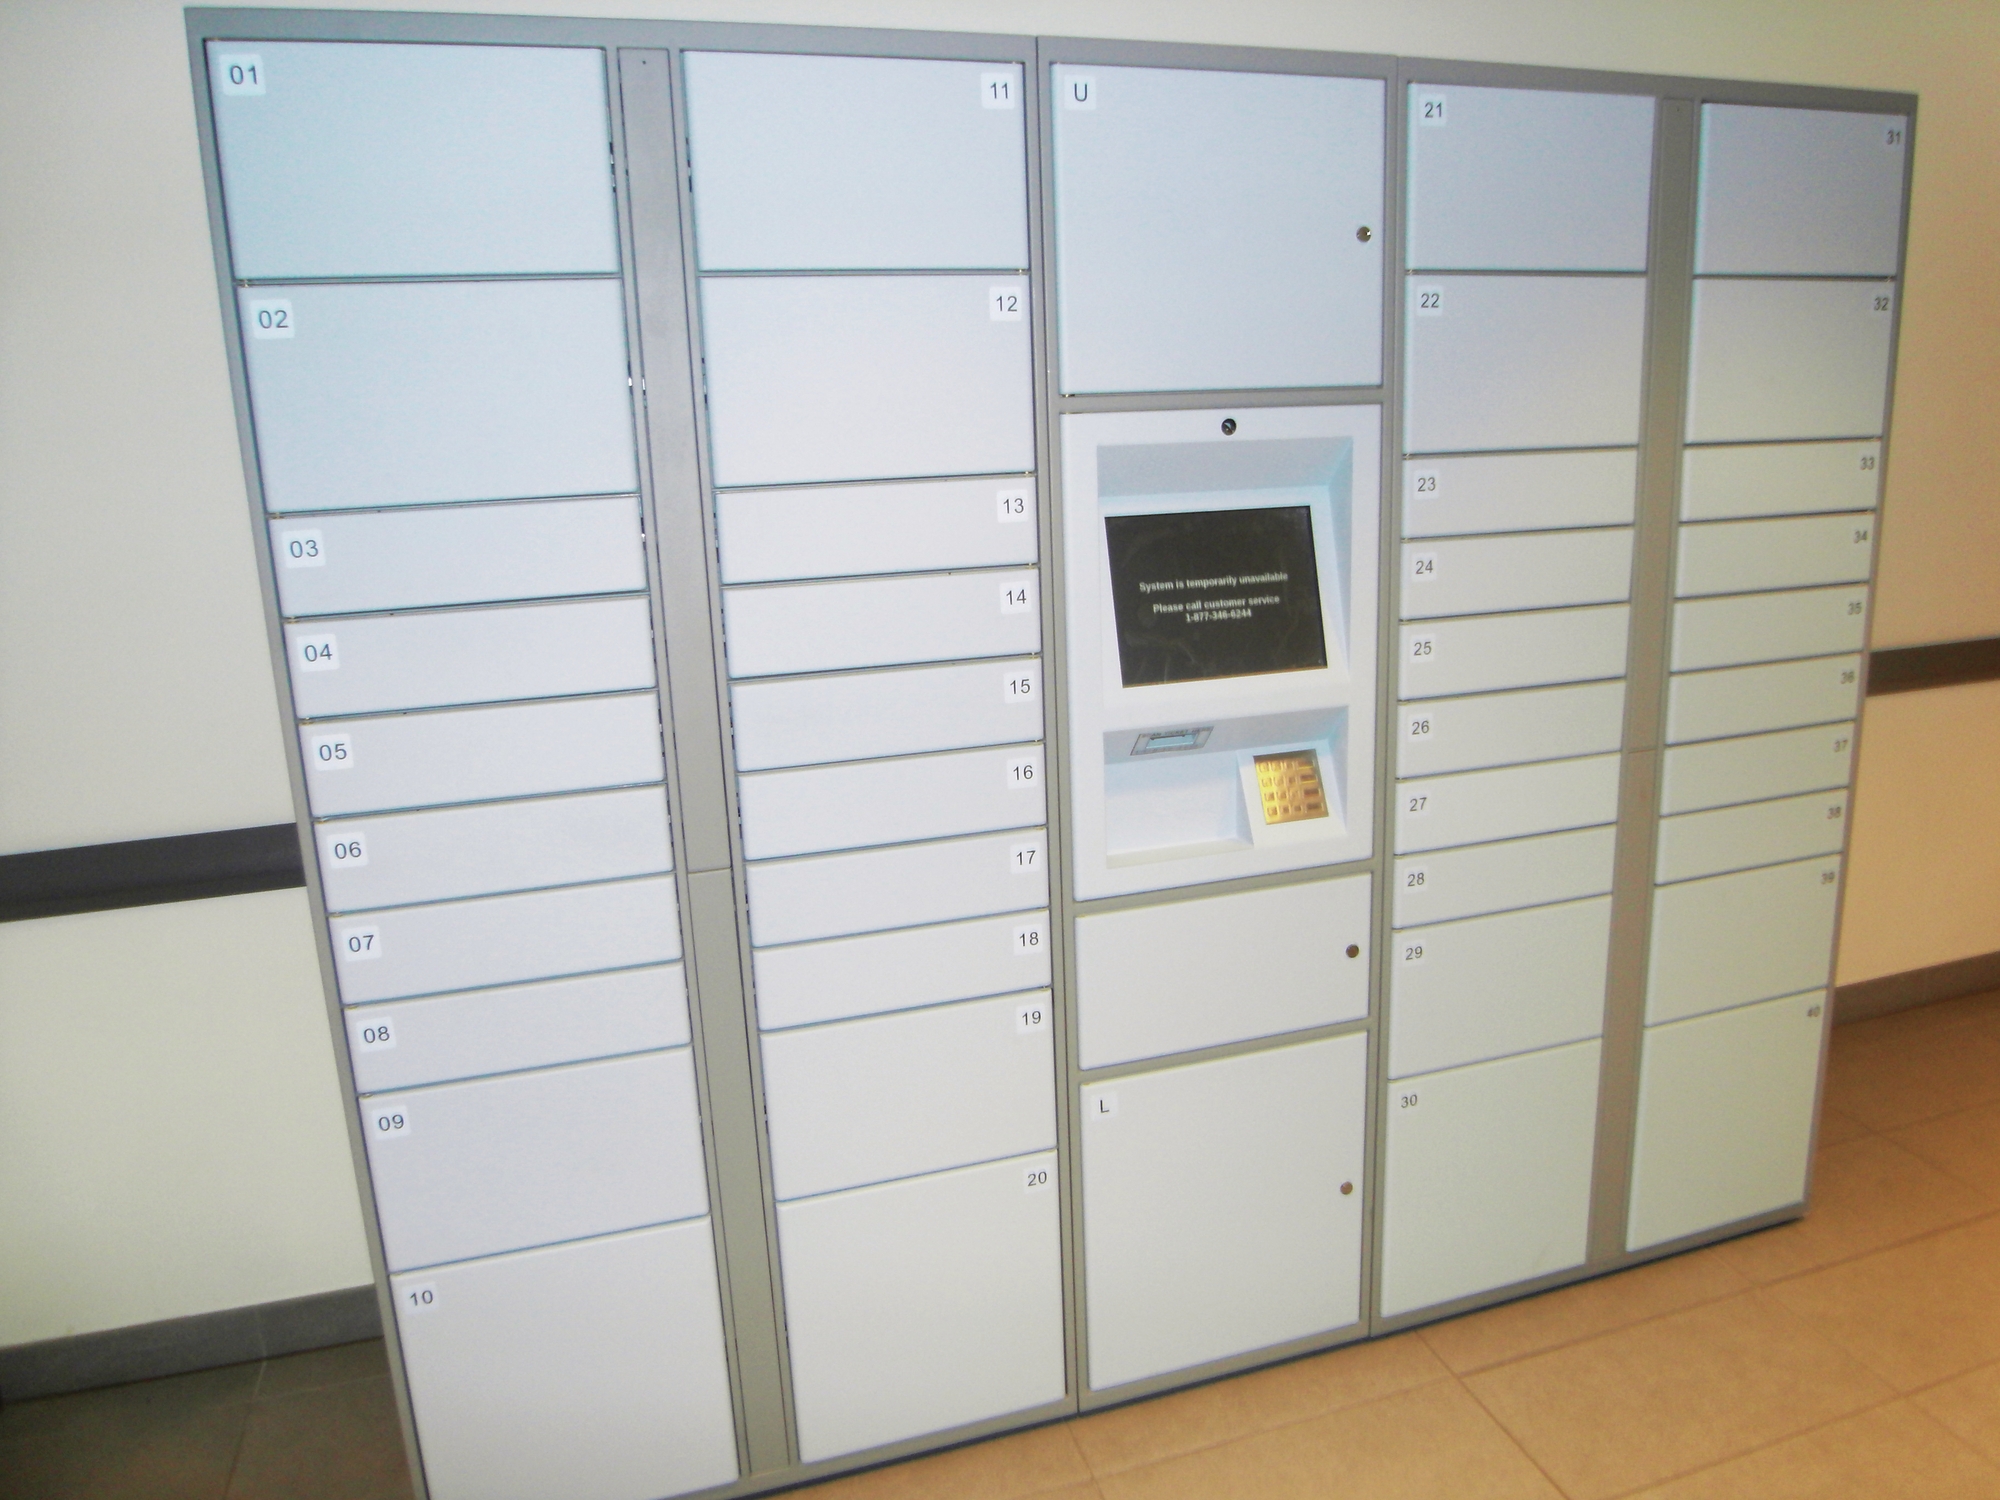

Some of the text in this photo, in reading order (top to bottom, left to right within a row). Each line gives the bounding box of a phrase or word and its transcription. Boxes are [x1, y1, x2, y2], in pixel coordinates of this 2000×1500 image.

[229, 65, 258, 85] 01
[990, 82, 1008, 99] 11
[1074, 83, 1088, 102] U
[1424, 101, 1442, 118] 21
[1887, 129, 1902, 145] 31
[996, 295, 1018, 312] 12
[1420, 292, 1440, 309] 22
[1874, 296, 1890, 312] 32
[258, 309, 289, 329] 02
[1860, 455, 1876, 471] 33
[1417, 476, 1436, 492] 23
[1003, 497, 1025, 514] 13
[1854, 530, 1869, 545] 34
[289, 539, 319, 559] 03
[1415, 559, 1434, 575] 24
[1139, 571, 1289, 594] System is temporarily unavailable
[1006, 588, 1027, 606] 14
[1153, 595, 1280, 614] Please call customer service
[304, 643, 333, 663] 04
[1413, 641, 1432, 656] 25
[1010, 678, 1031, 695] 15
[1411, 719, 1430, 736] 26
[319, 743, 347, 762] 05
[1013, 764, 1034, 781] 16
[1409, 796, 1428, 812] 27
[334, 841, 362, 860] 06
[1016, 849, 1036, 866] 17
[1407, 872, 1425, 887] 28
[348, 934, 374, 953] 07
[1019, 931, 1039, 947] 18
[1405, 945, 1423, 961] 29
[1022, 1010, 1042, 1026] 19
[363, 1025, 390, 1044] 08
[1099, 1099, 1110, 1114] L
[1400, 1093, 1418, 1109] 30
[378, 1114, 404, 1132] 09
[1027, 1171, 1048, 1187] 20
[409, 1290, 434, 1306] 10
